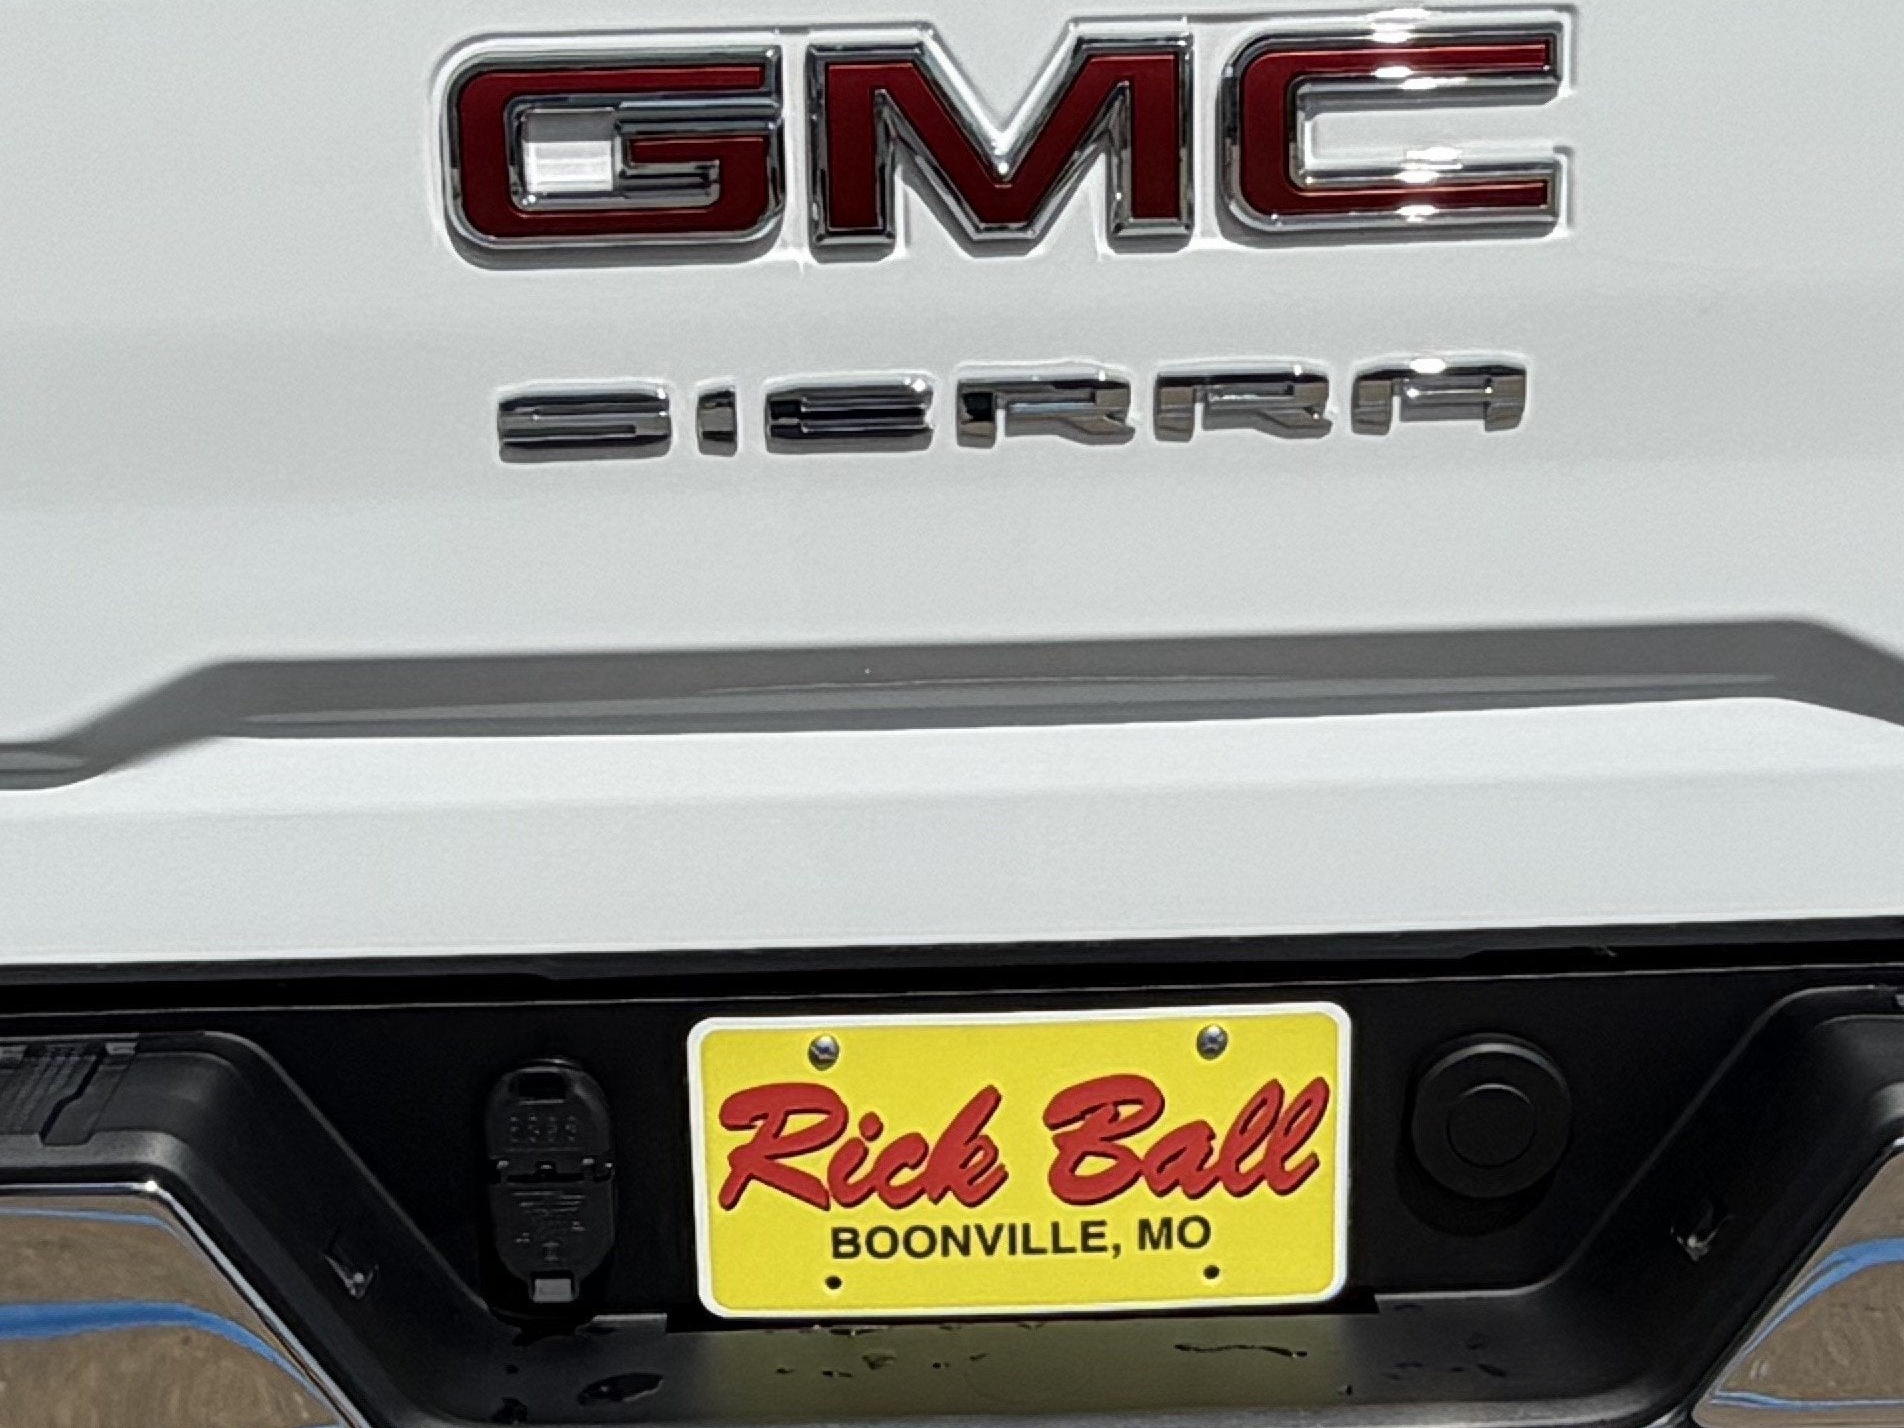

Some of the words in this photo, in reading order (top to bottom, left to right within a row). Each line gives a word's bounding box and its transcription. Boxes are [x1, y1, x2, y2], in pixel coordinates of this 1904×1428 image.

[444, 10, 1570, 264] GMC
[496, 360, 1528, 464] SIERRA
[717, 1080, 1008, 1214] Rick
[1041, 1072, 1331, 1208] Ball
[829, 1220, 1123, 1262] BOONVILLE,
[1136, 1214, 1214, 1254] MO
